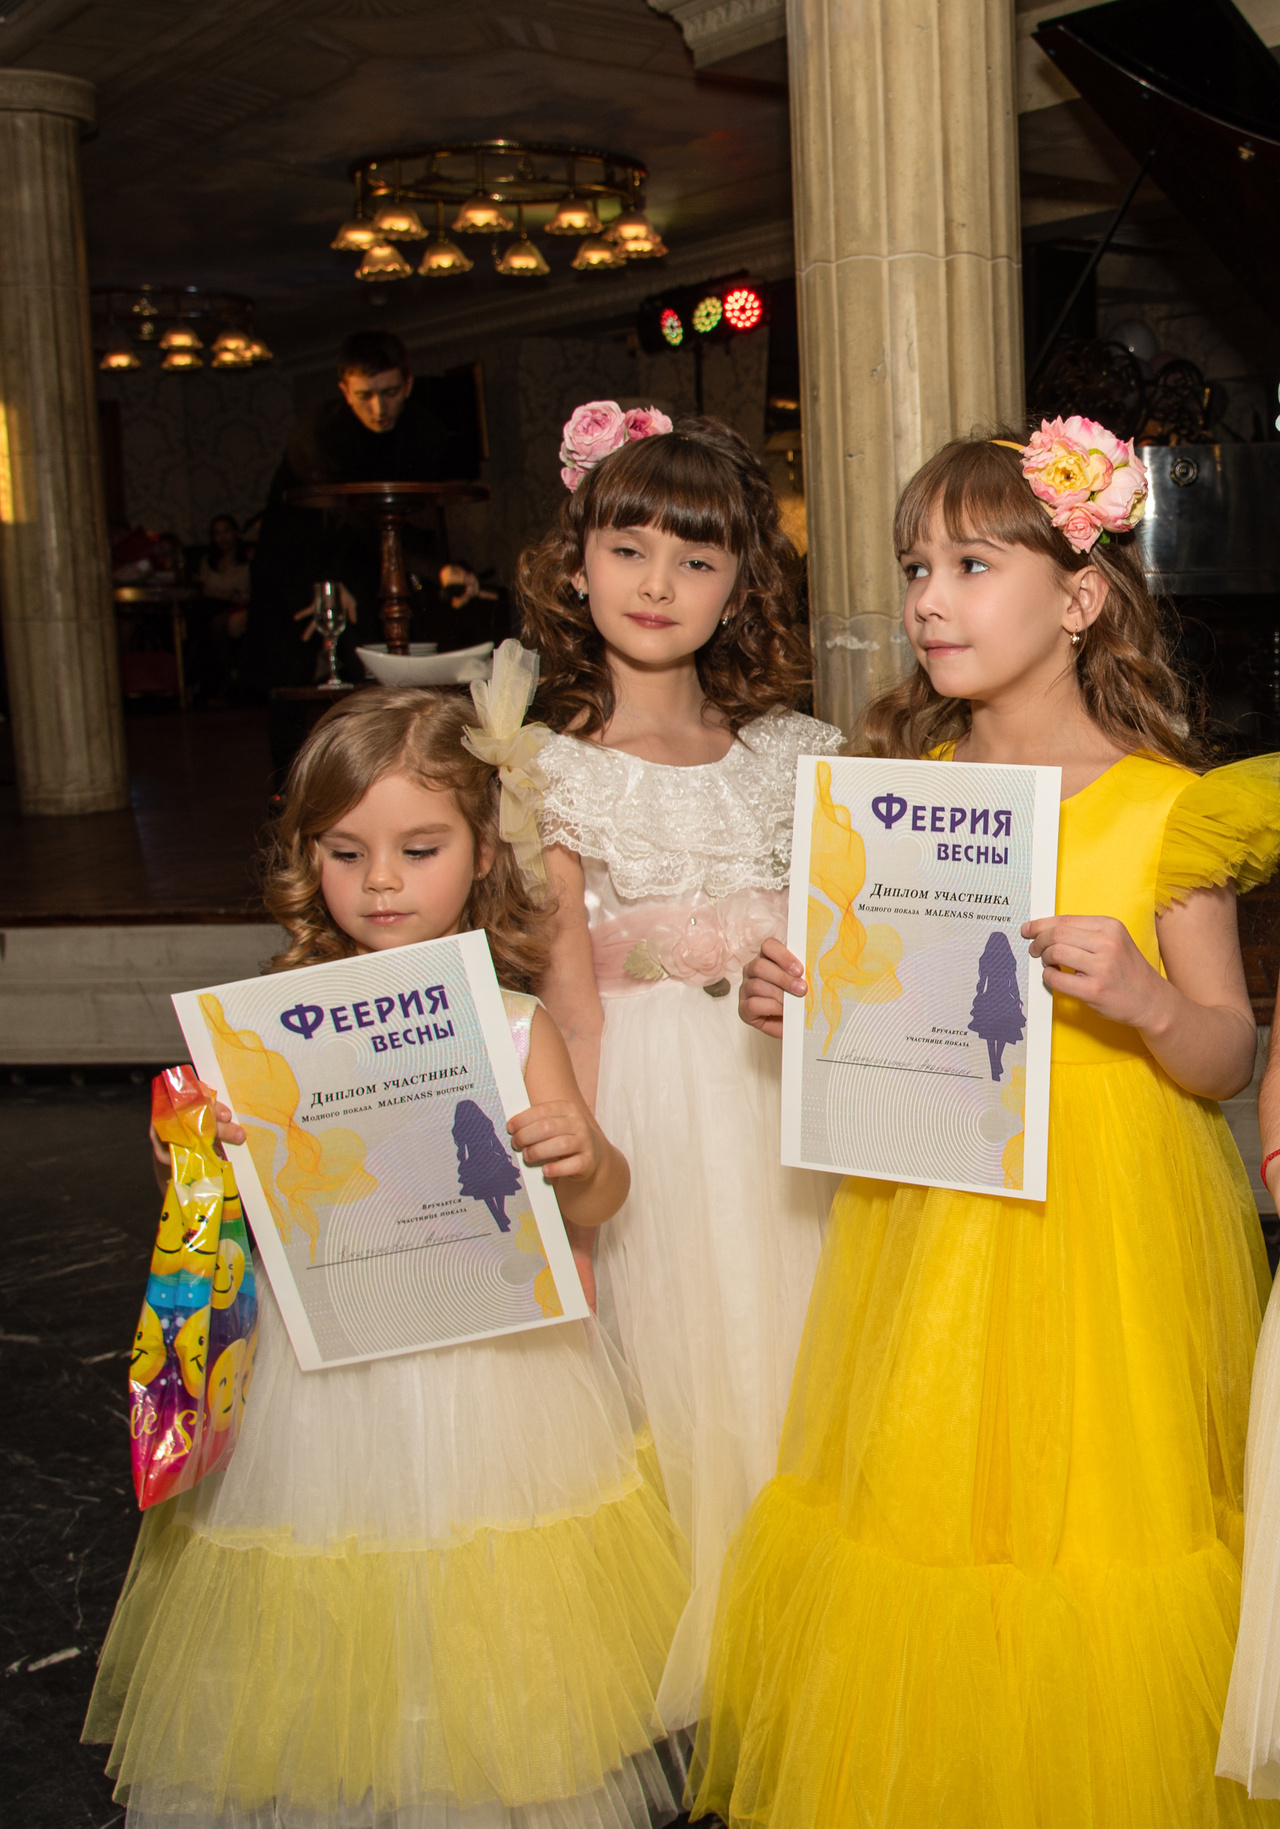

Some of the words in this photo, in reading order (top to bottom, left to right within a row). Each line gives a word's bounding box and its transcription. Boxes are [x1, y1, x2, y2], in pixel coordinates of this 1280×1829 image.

[871, 793, 1012, 837] ФЕЕРИЯ
[937, 843, 1009, 865] ВЕСНЫ
[925, 909, 973, 920] MALENASS
[280, 985, 449, 1039] ФЕЕРИЯ
[371, 1021, 455, 1053] ВЕСНЫ
[378, 1090, 432, 1108] MALENASS
